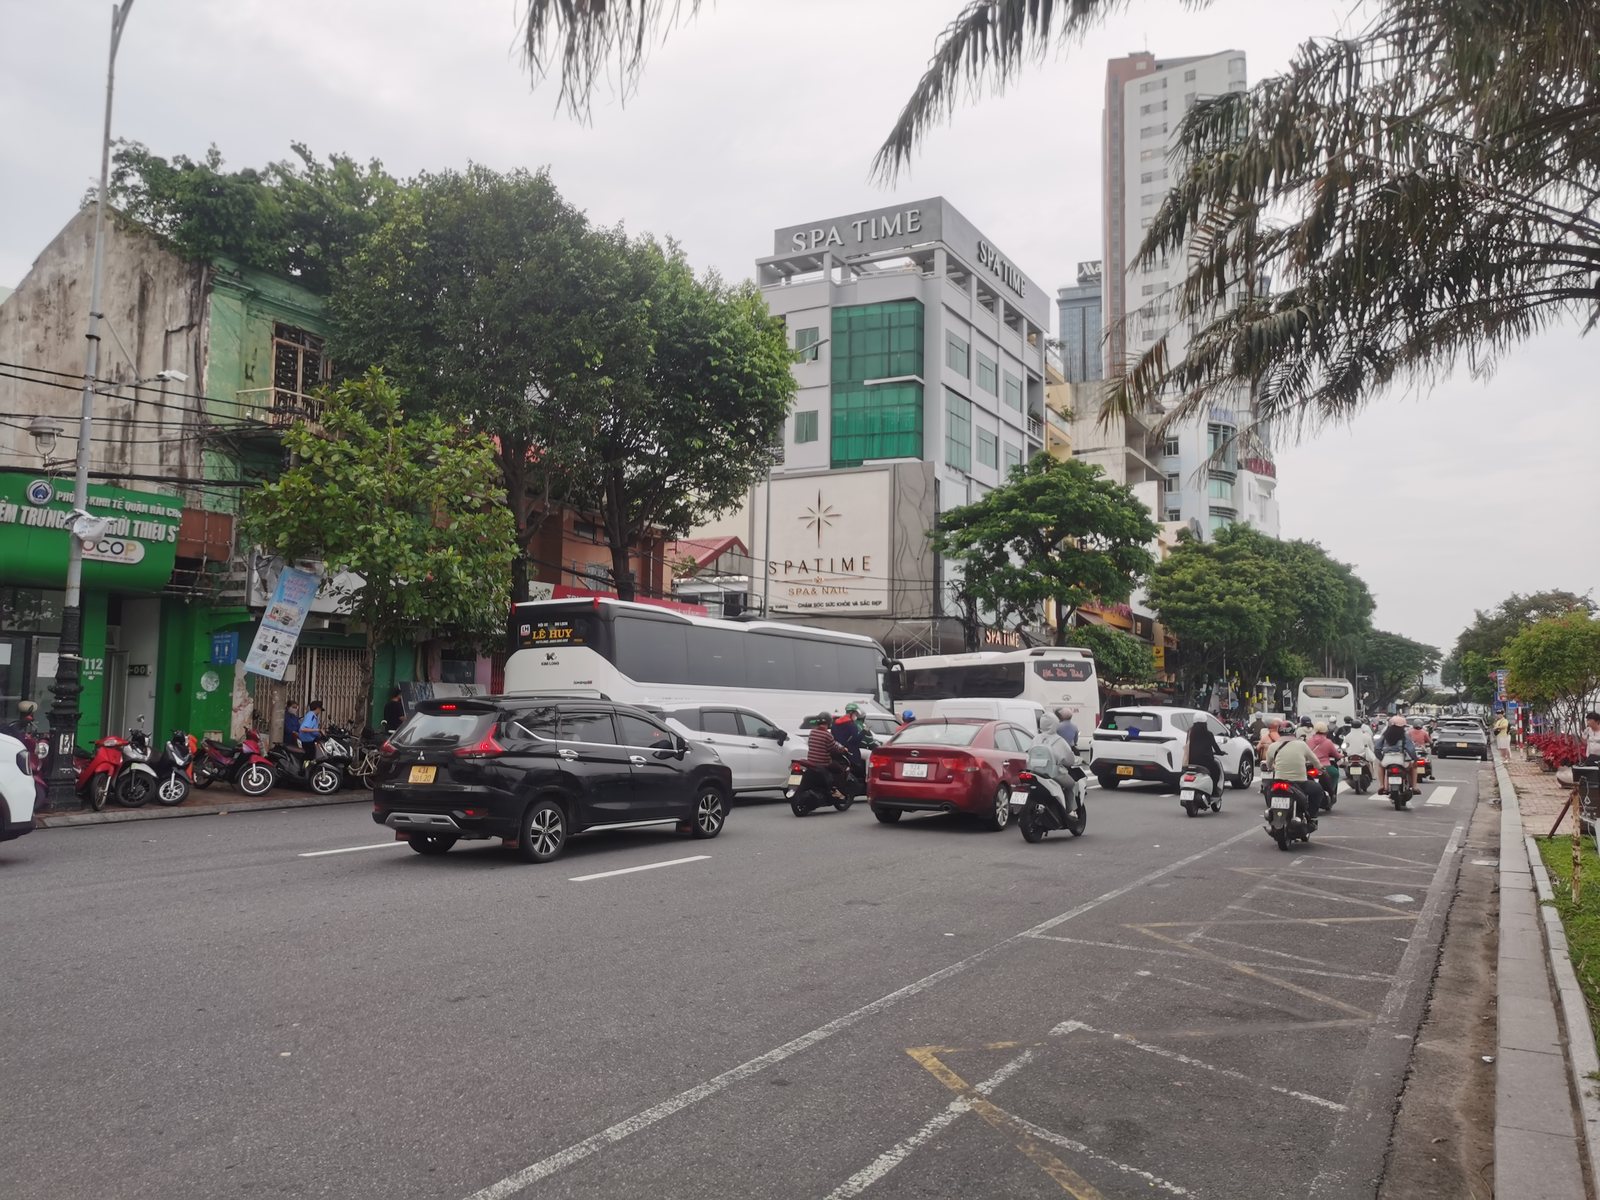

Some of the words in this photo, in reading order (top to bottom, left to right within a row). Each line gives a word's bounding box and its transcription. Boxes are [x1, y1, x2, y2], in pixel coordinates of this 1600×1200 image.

[791, 225, 844, 253] SPA
[852, 208, 922, 243] TIME
[977, 239, 1001, 277] SPA
[1001, 260, 1027, 299] TIME
[56, 490, 88, 503] PHÒ
[89, 496, 111, 507] KINH
[112, 496, 125, 509] TẾ
[125, 501, 149, 514] QUẬN
[149, 503, 165, 515] HẢI
[20, 505, 67, 529] TRƯNG
[132, 520, 167, 543] THIỆU
[82, 540, 137, 556] OCOP
[821, 586, 849, 595] NAIL
[532, 628, 546, 640] LÊ
[549, 628, 573, 639] HUY
[986, 629, 1001, 645] SPA
[1002, 630, 1020, 648] TIME
[84, 658, 103, 670] 112
